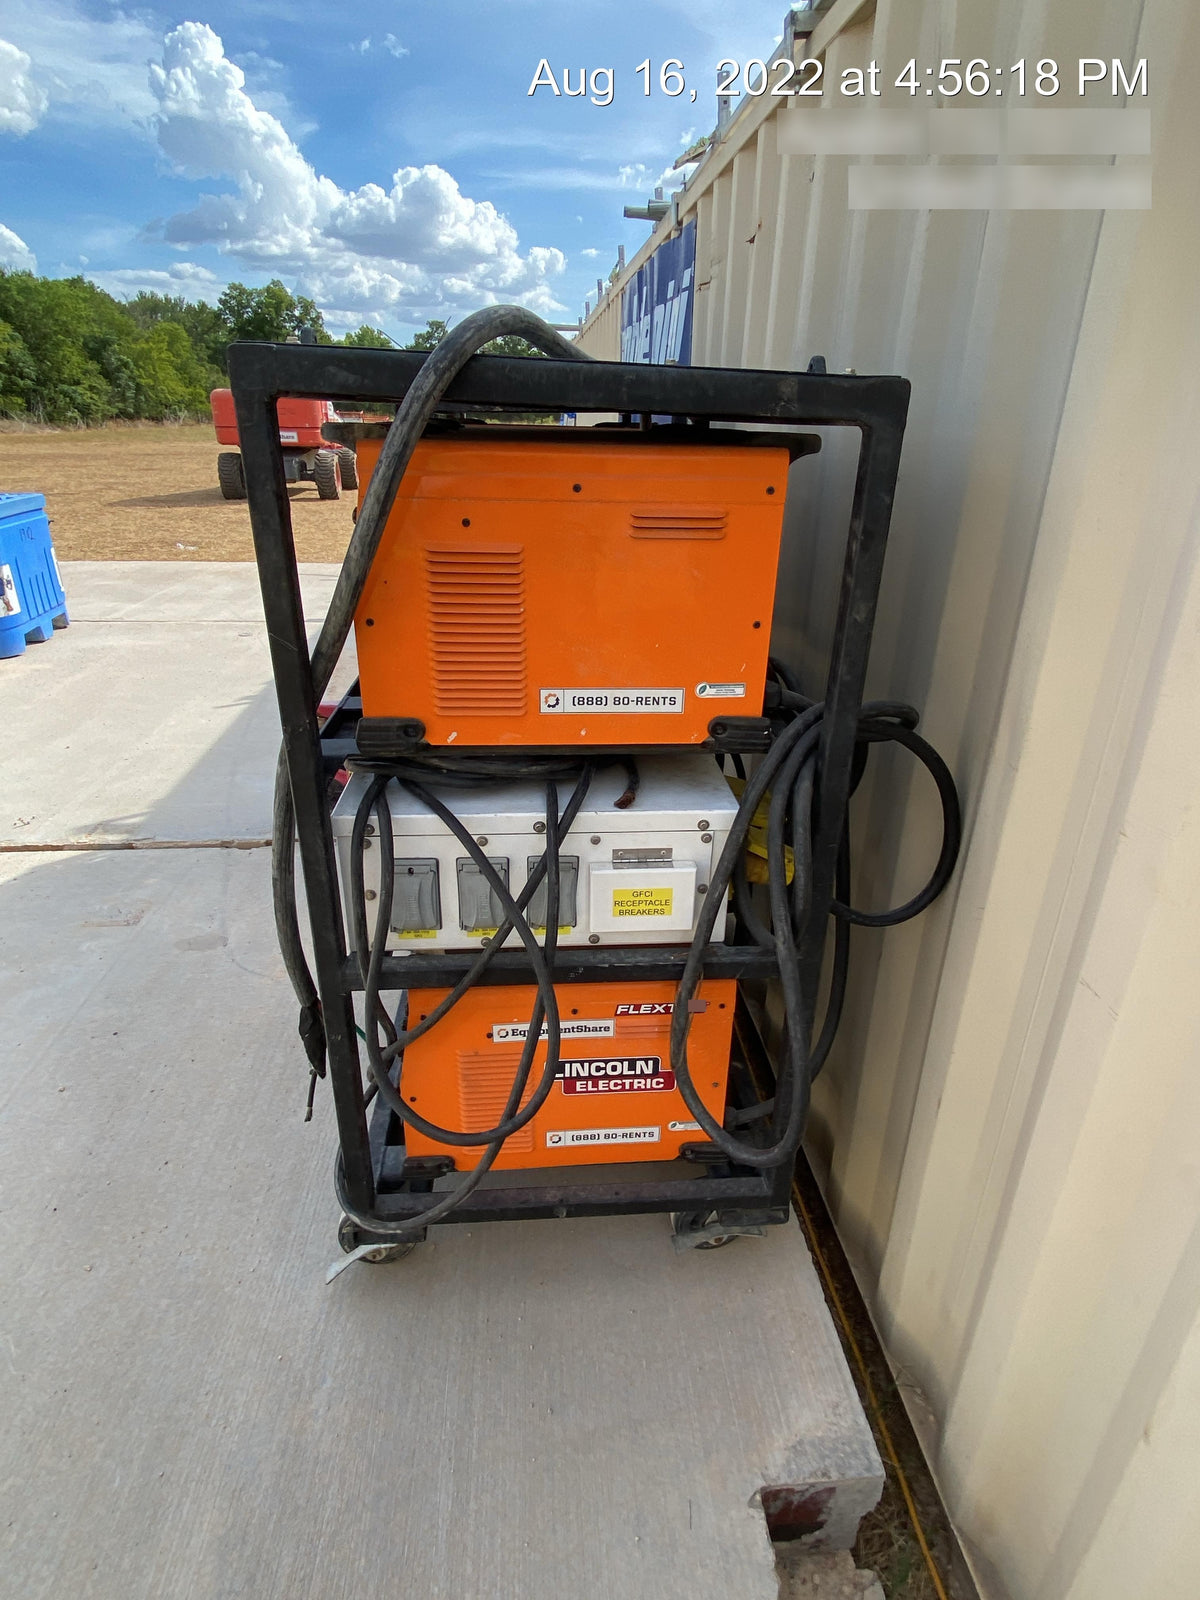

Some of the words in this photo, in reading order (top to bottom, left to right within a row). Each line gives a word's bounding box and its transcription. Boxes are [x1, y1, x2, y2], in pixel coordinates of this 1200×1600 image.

[572, 696, 608, 706] (888)
[613, 696, 677, 706] 80-RENTS
[614, 899, 670, 907] RECEPTACLE
[618, 908, 665, 916] BREAKERS
[575, 1077, 665, 1092] ELECTRIC
[571, 1133, 600, 1142] (888)
[603, 1131, 655, 1140] 80-RENTS
